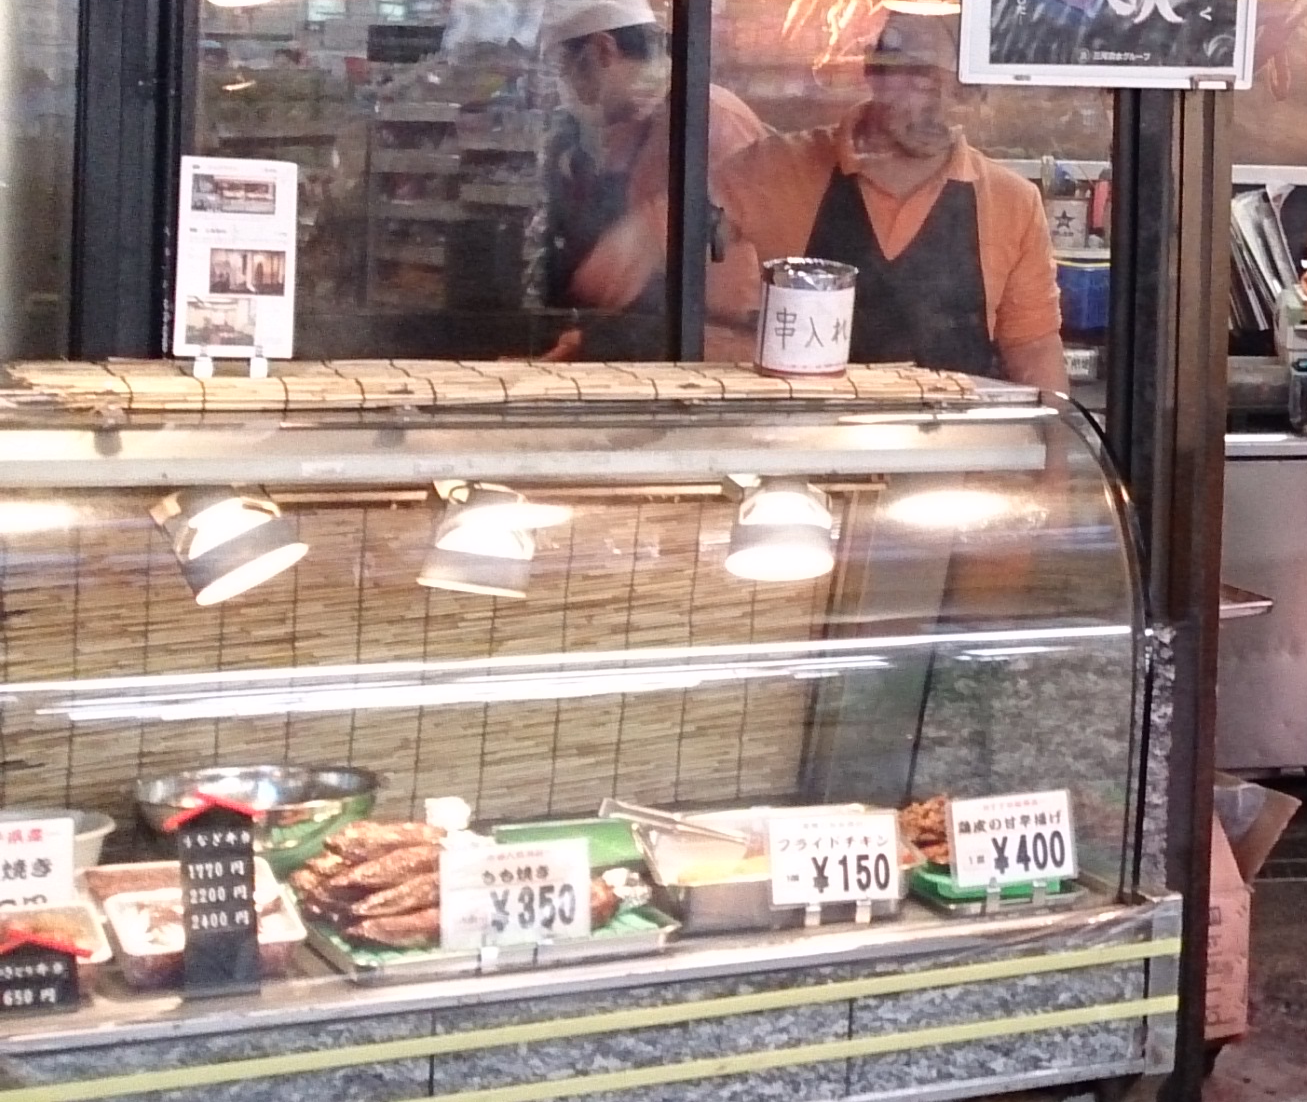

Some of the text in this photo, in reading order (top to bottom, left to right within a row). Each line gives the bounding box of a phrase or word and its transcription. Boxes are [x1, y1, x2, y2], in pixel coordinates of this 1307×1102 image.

[778, 835, 888, 852] フライドチキン
[991, 830, 1065, 875] ¥400
[189, 862, 223, 879] 1770
[811, 853, 890, 894] ¥150
[190, 886, 226, 904] 2200
[490, 884, 576, 932] ¥350
